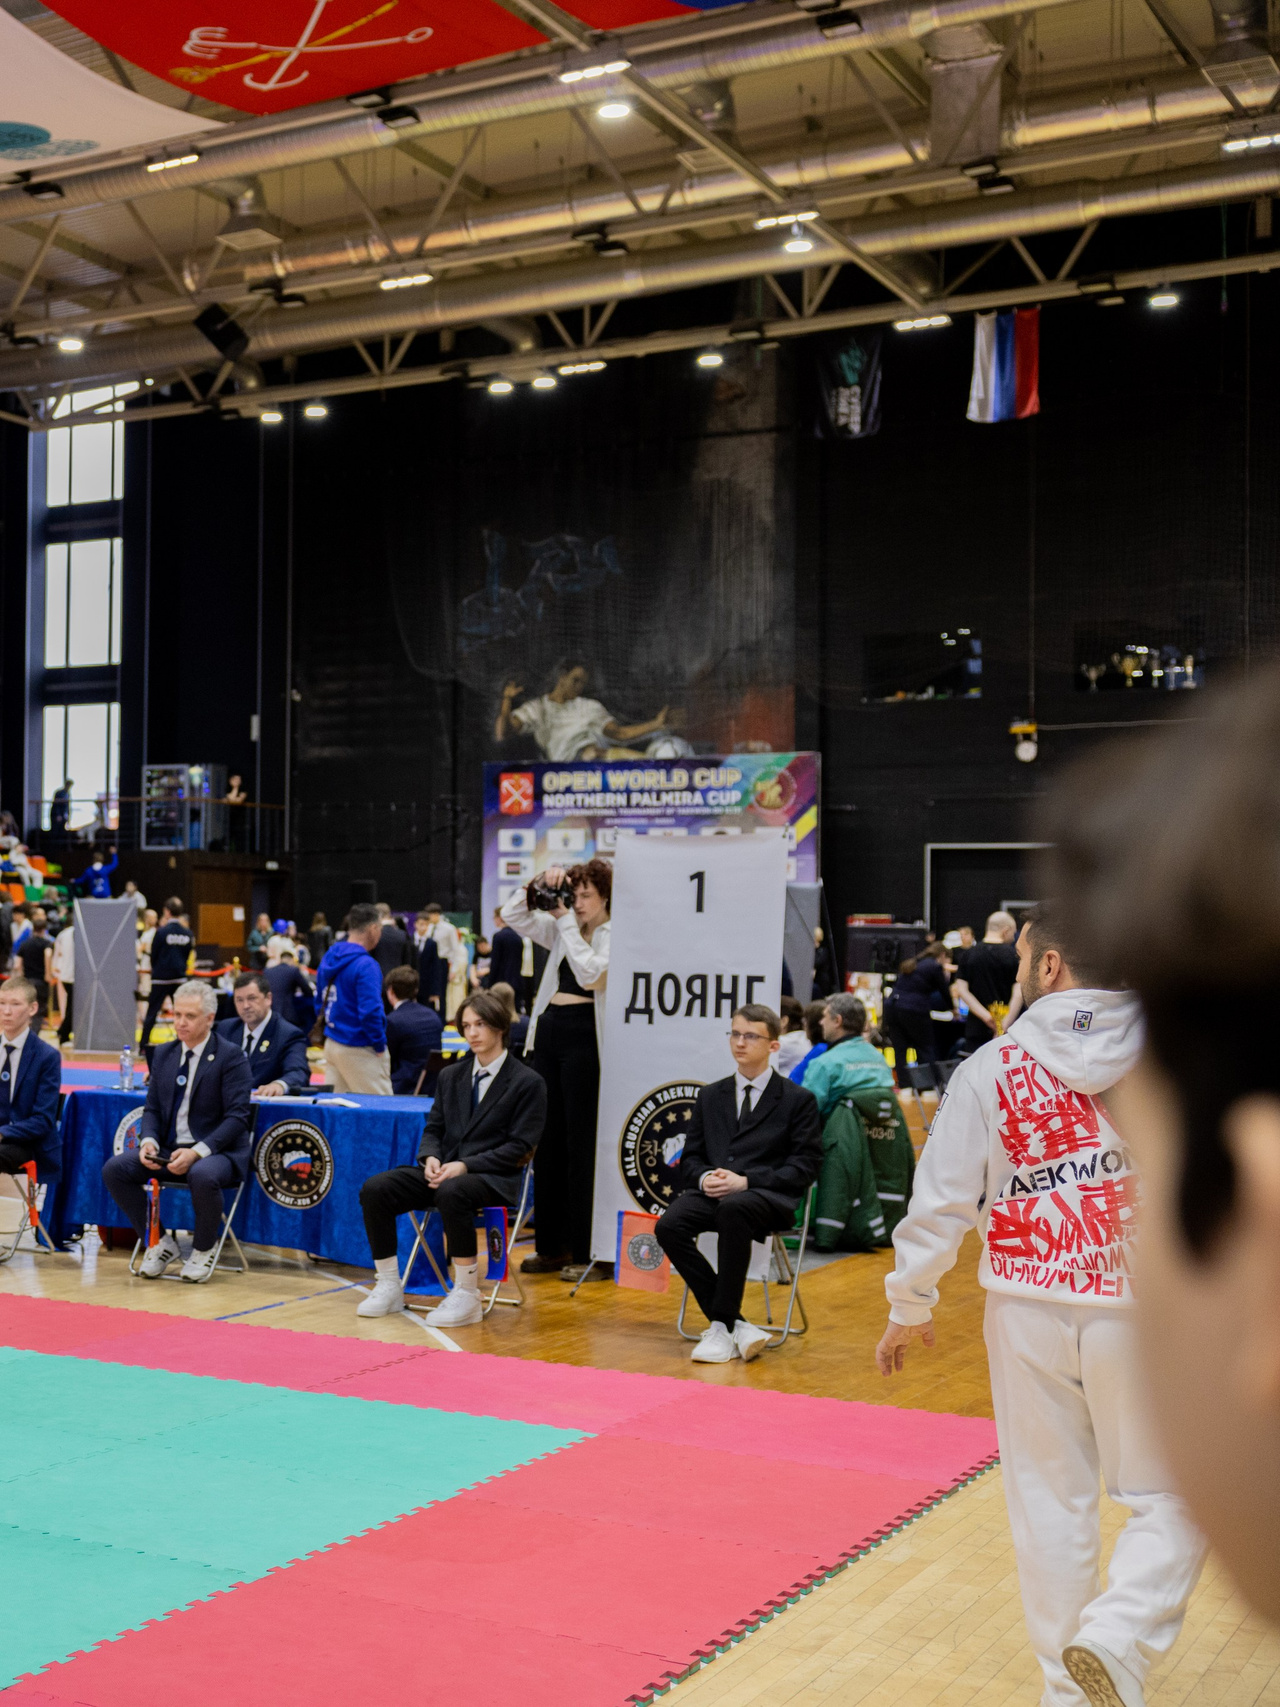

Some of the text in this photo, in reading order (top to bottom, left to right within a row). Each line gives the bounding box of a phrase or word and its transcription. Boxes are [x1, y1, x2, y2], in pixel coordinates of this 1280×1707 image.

[543, 767, 742, 792] OPEN WORLD CUP
[543, 790, 742, 808] NORTHERN PALMIRA CUP
[689, 870, 705, 913] 1
[624, 971, 765, 1025] ДОЯНГ
[624, 1100, 656, 1177] ALL-RUSSIAN
[1000, 1148, 1132, 1198] AEKWO
